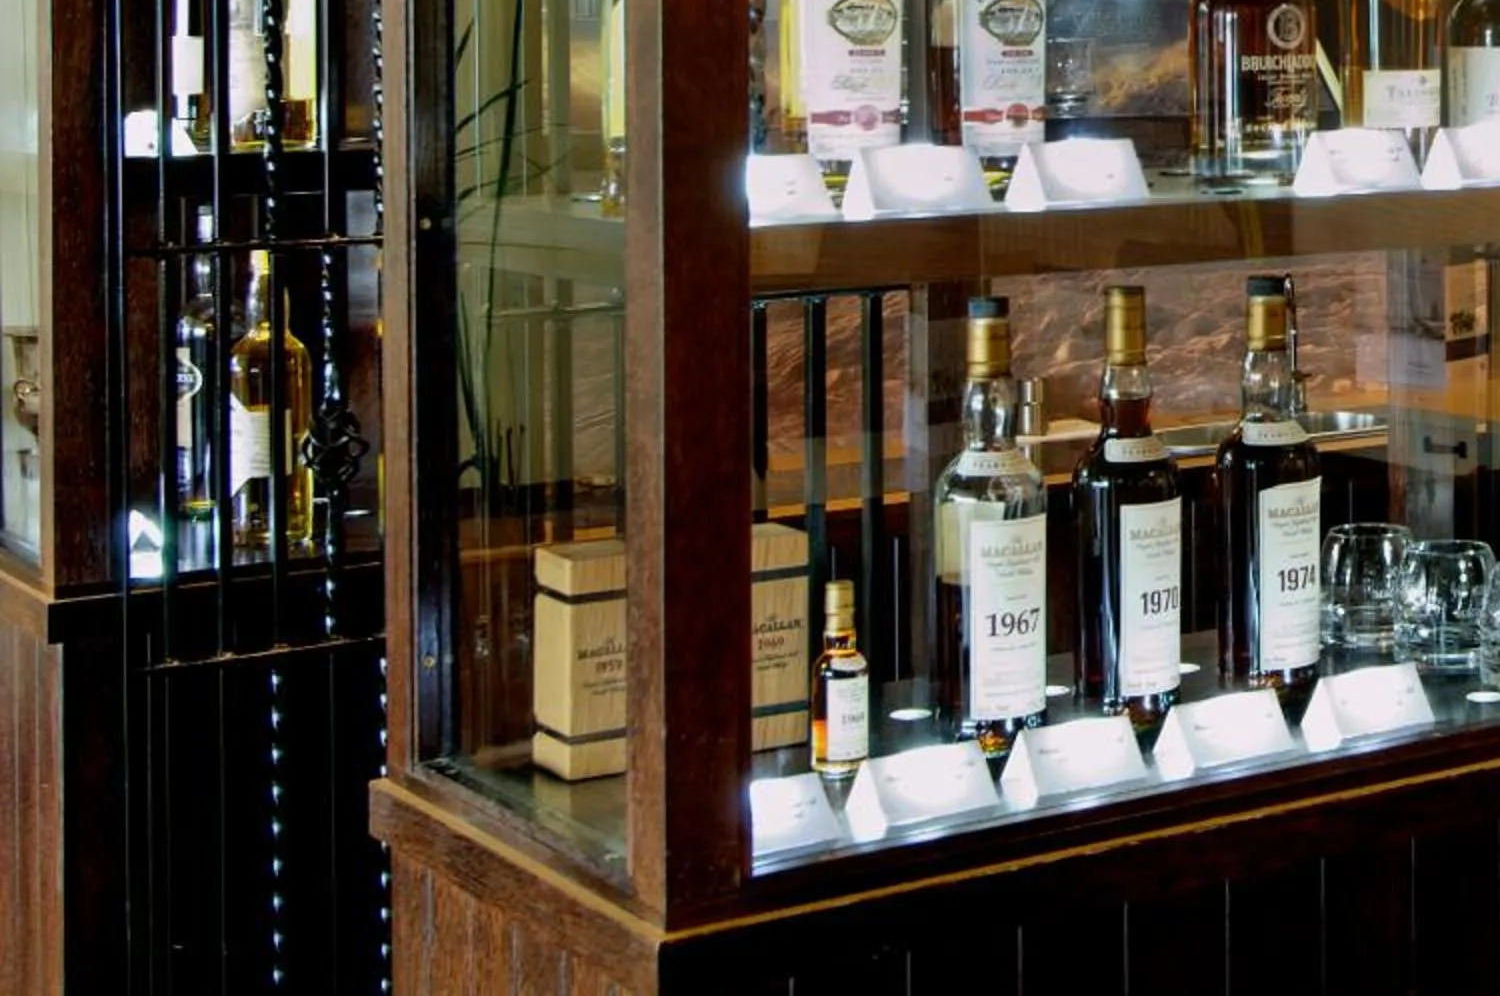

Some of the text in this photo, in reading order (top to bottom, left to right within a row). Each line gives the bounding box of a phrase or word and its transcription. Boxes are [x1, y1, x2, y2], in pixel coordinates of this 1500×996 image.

[1277, 564, 1315, 593] 1974
[1140, 585, 1179, 615] 1970
[987, 607, 1041, 638] 1967
